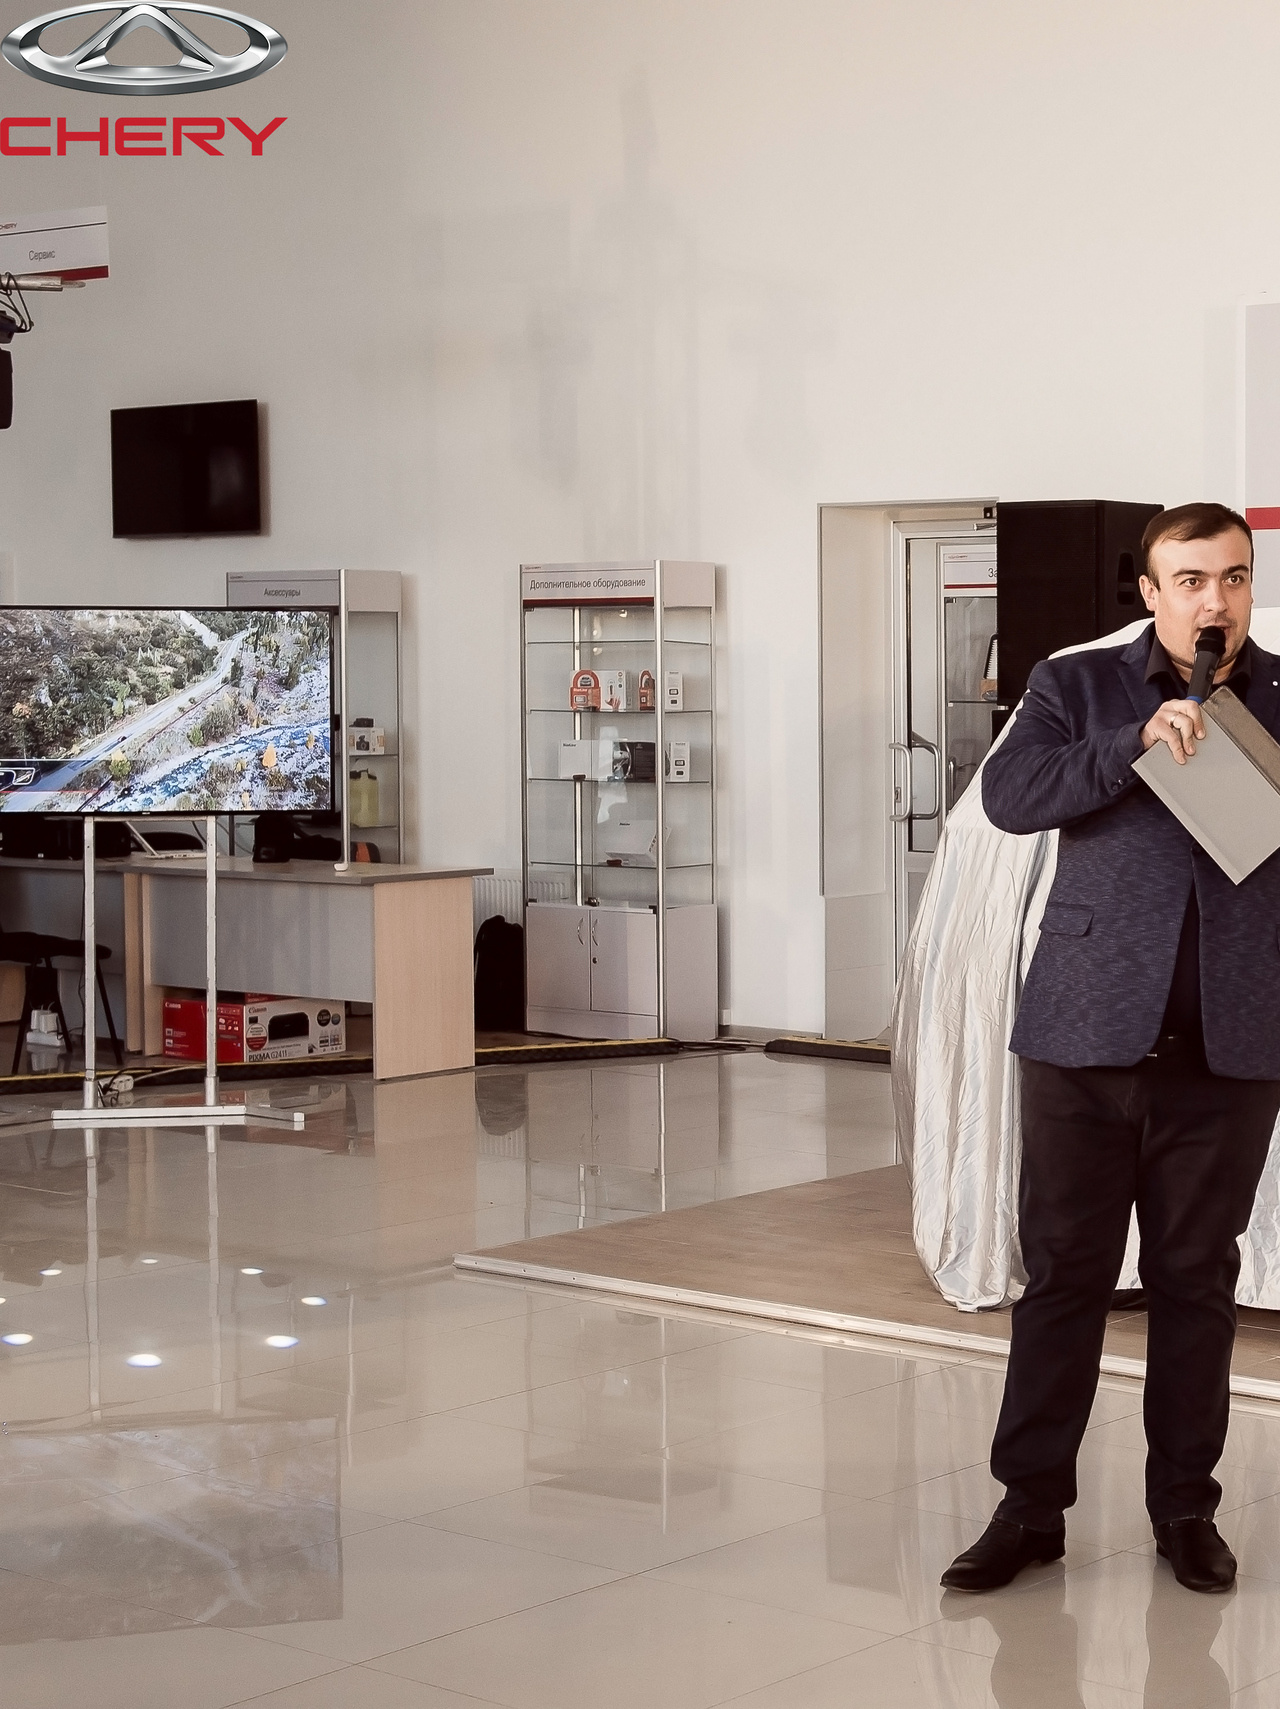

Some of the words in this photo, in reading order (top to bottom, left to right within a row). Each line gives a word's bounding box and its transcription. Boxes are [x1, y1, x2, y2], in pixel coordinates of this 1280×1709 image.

[28, 250, 56, 261] Сервис
[529, 579, 592, 591] Дополнительное
[593, 577, 646, 589] оборудование
[263, 588, 301, 598] Аксессуары
[165, 1001, 181, 1009] Canon
[248, 1006, 267, 1014] Canon
[248, 1052, 270, 1062] PIXMA
